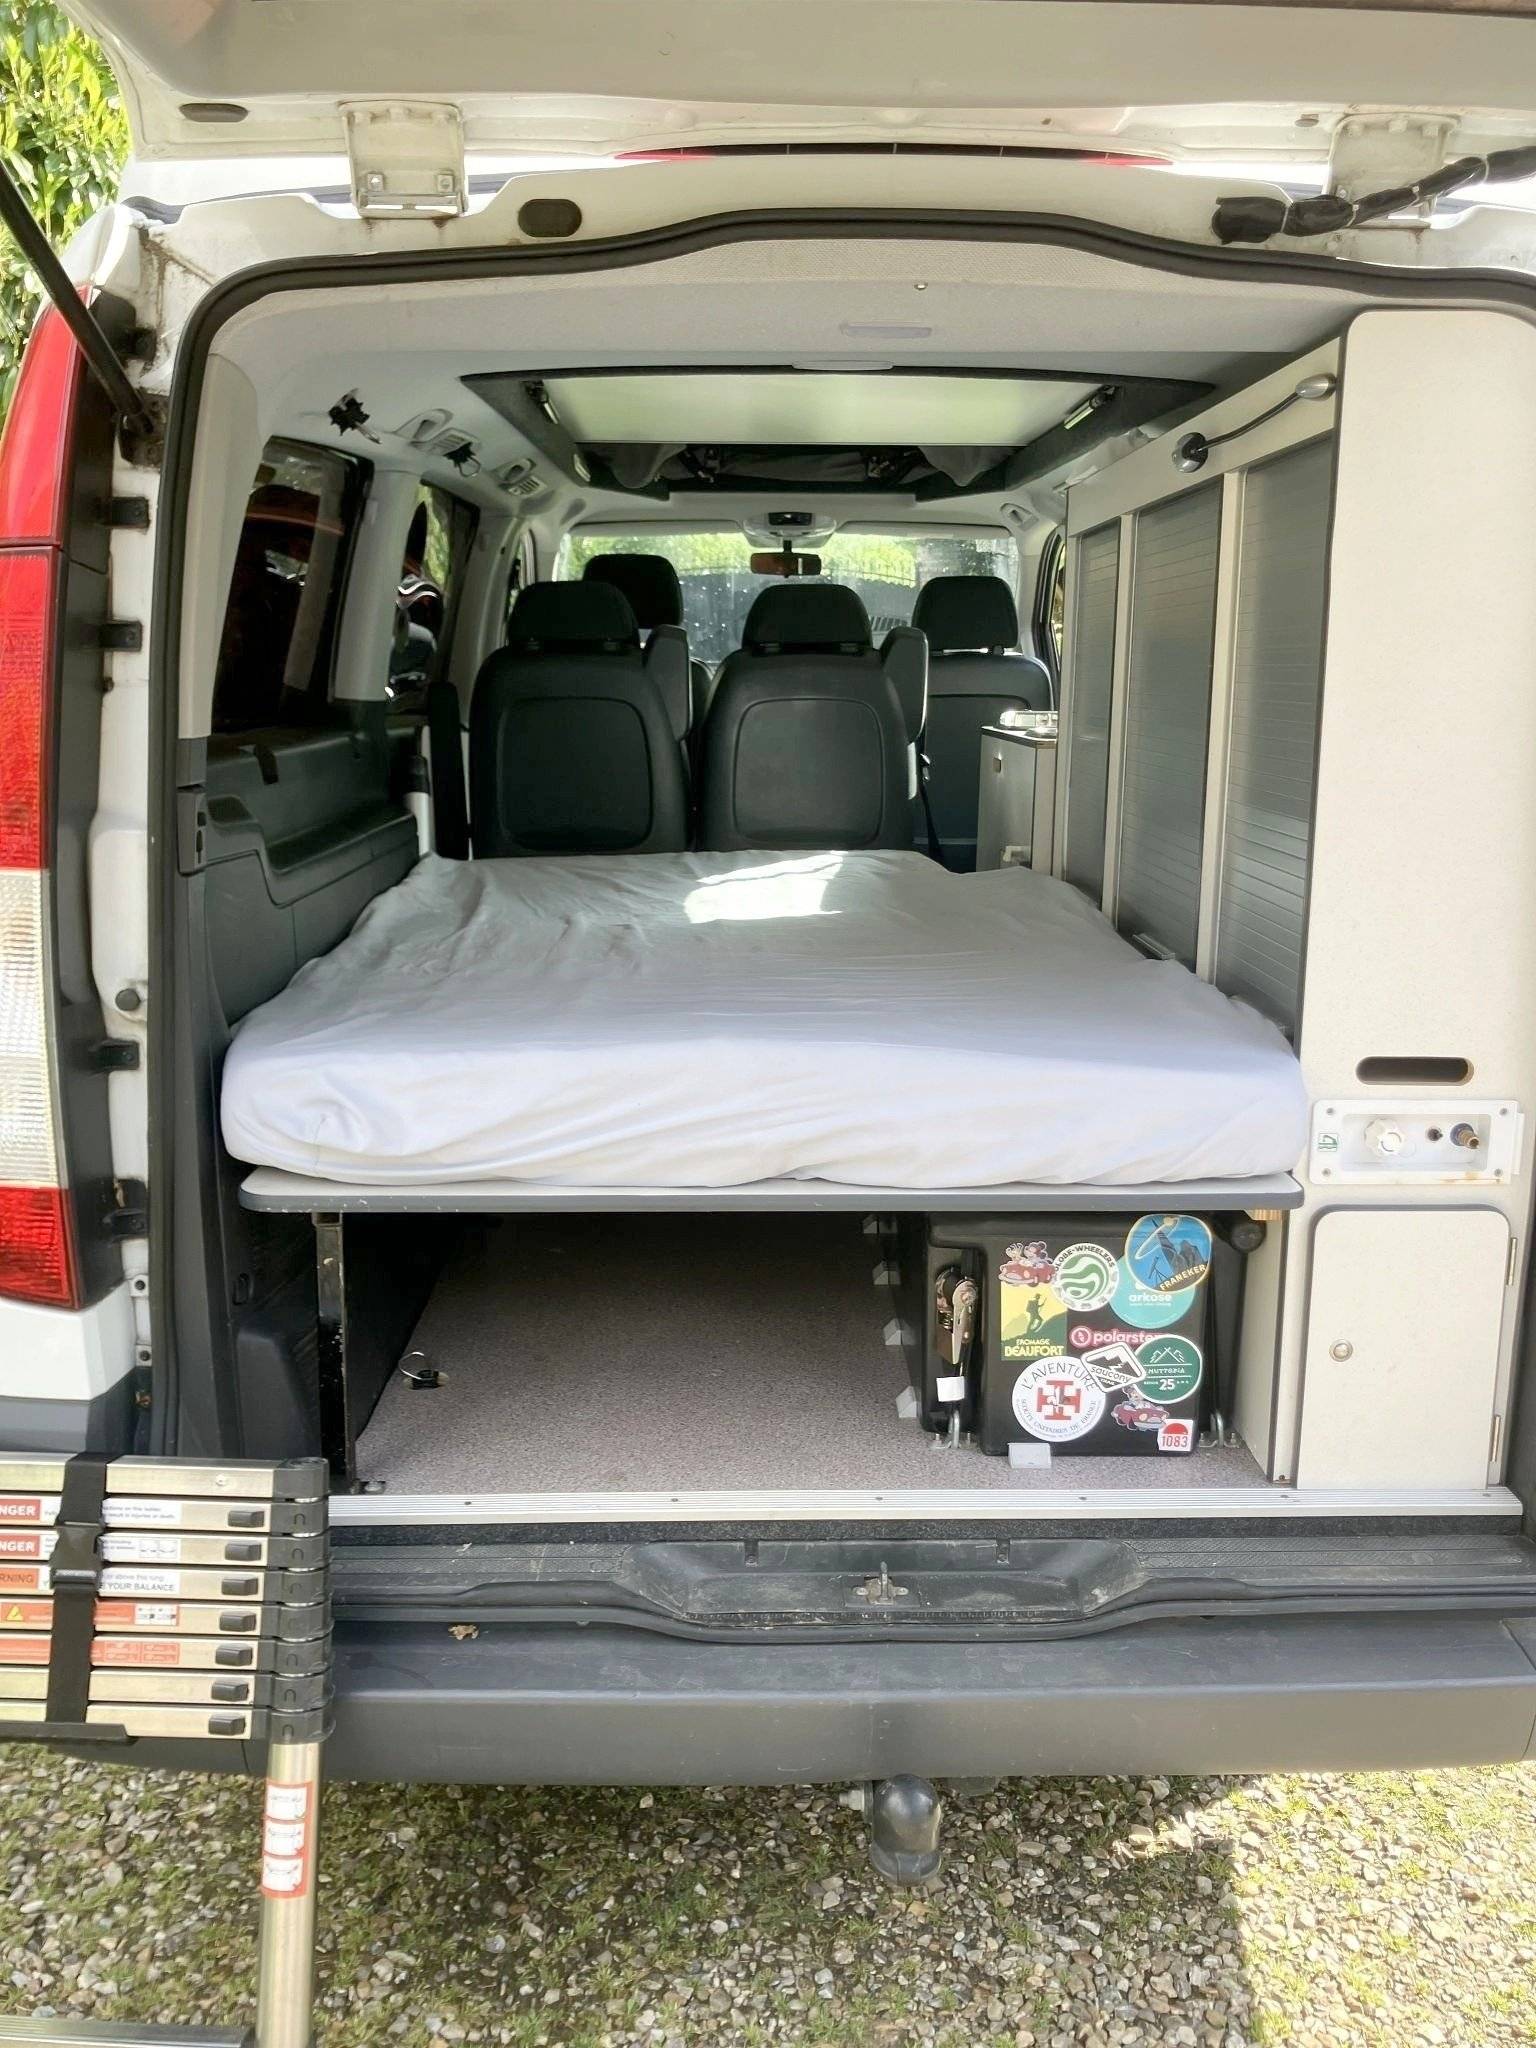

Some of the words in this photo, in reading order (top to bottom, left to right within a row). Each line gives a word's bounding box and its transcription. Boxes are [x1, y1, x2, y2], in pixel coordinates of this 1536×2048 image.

[1159, 1264, 1207, 1290] FRANEKER
[1128, 1292, 1172, 1302] arkose
[1093, 1330, 1159, 1345] polarste
[1004, 1345, 1064, 1357] BEAUFORT
[1091, 1366, 1132, 1383] saucony
[1158, 1378, 1176, 1391] 25
[1160, 1435, 1188, 1448] 1083
[134, 1583, 176, 1591] BALANCE
